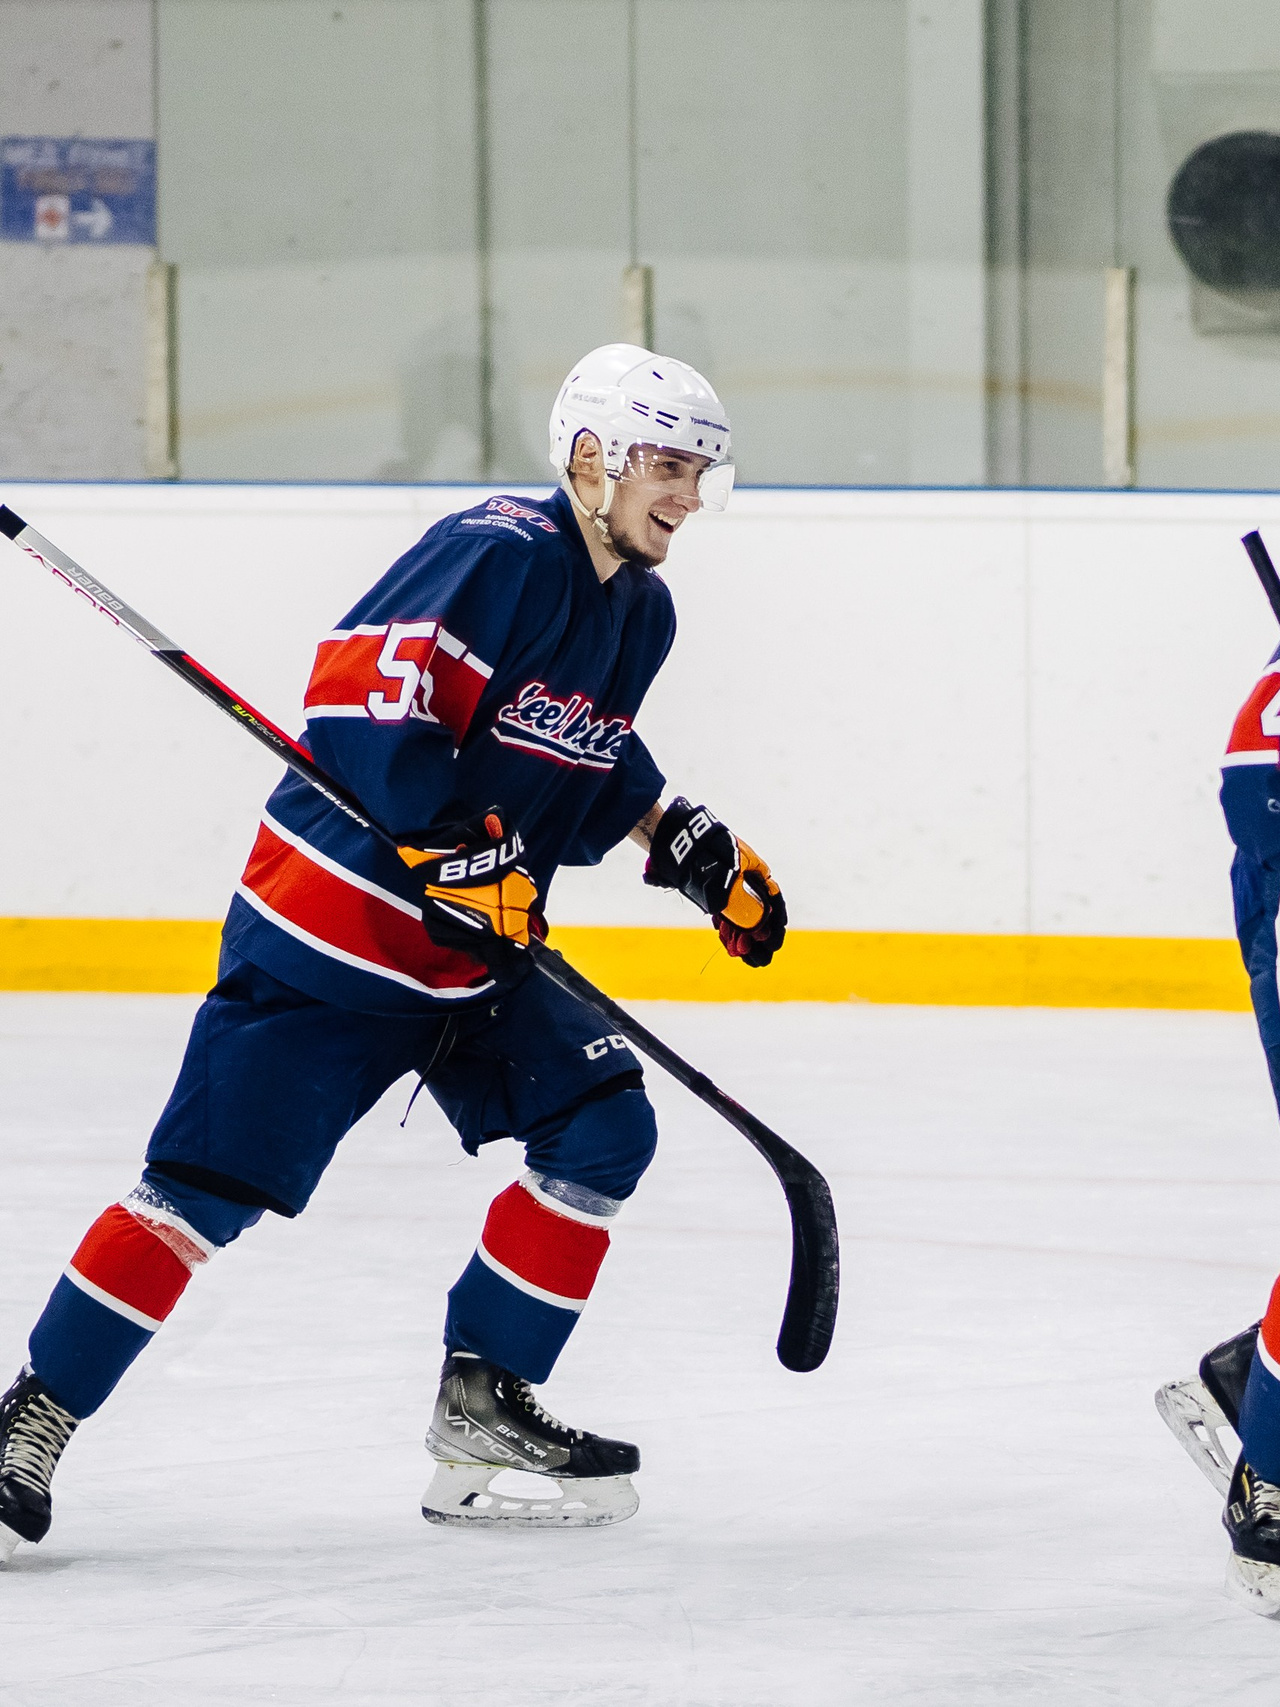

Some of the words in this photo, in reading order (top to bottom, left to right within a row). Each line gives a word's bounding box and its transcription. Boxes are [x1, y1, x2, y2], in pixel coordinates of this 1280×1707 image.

[460, 518, 492, 526] UNITED
[491, 520, 534, 542] COMPANY
[485, 514, 518, 525] MINING
[231, 704, 286, 748] HYPERLITE
